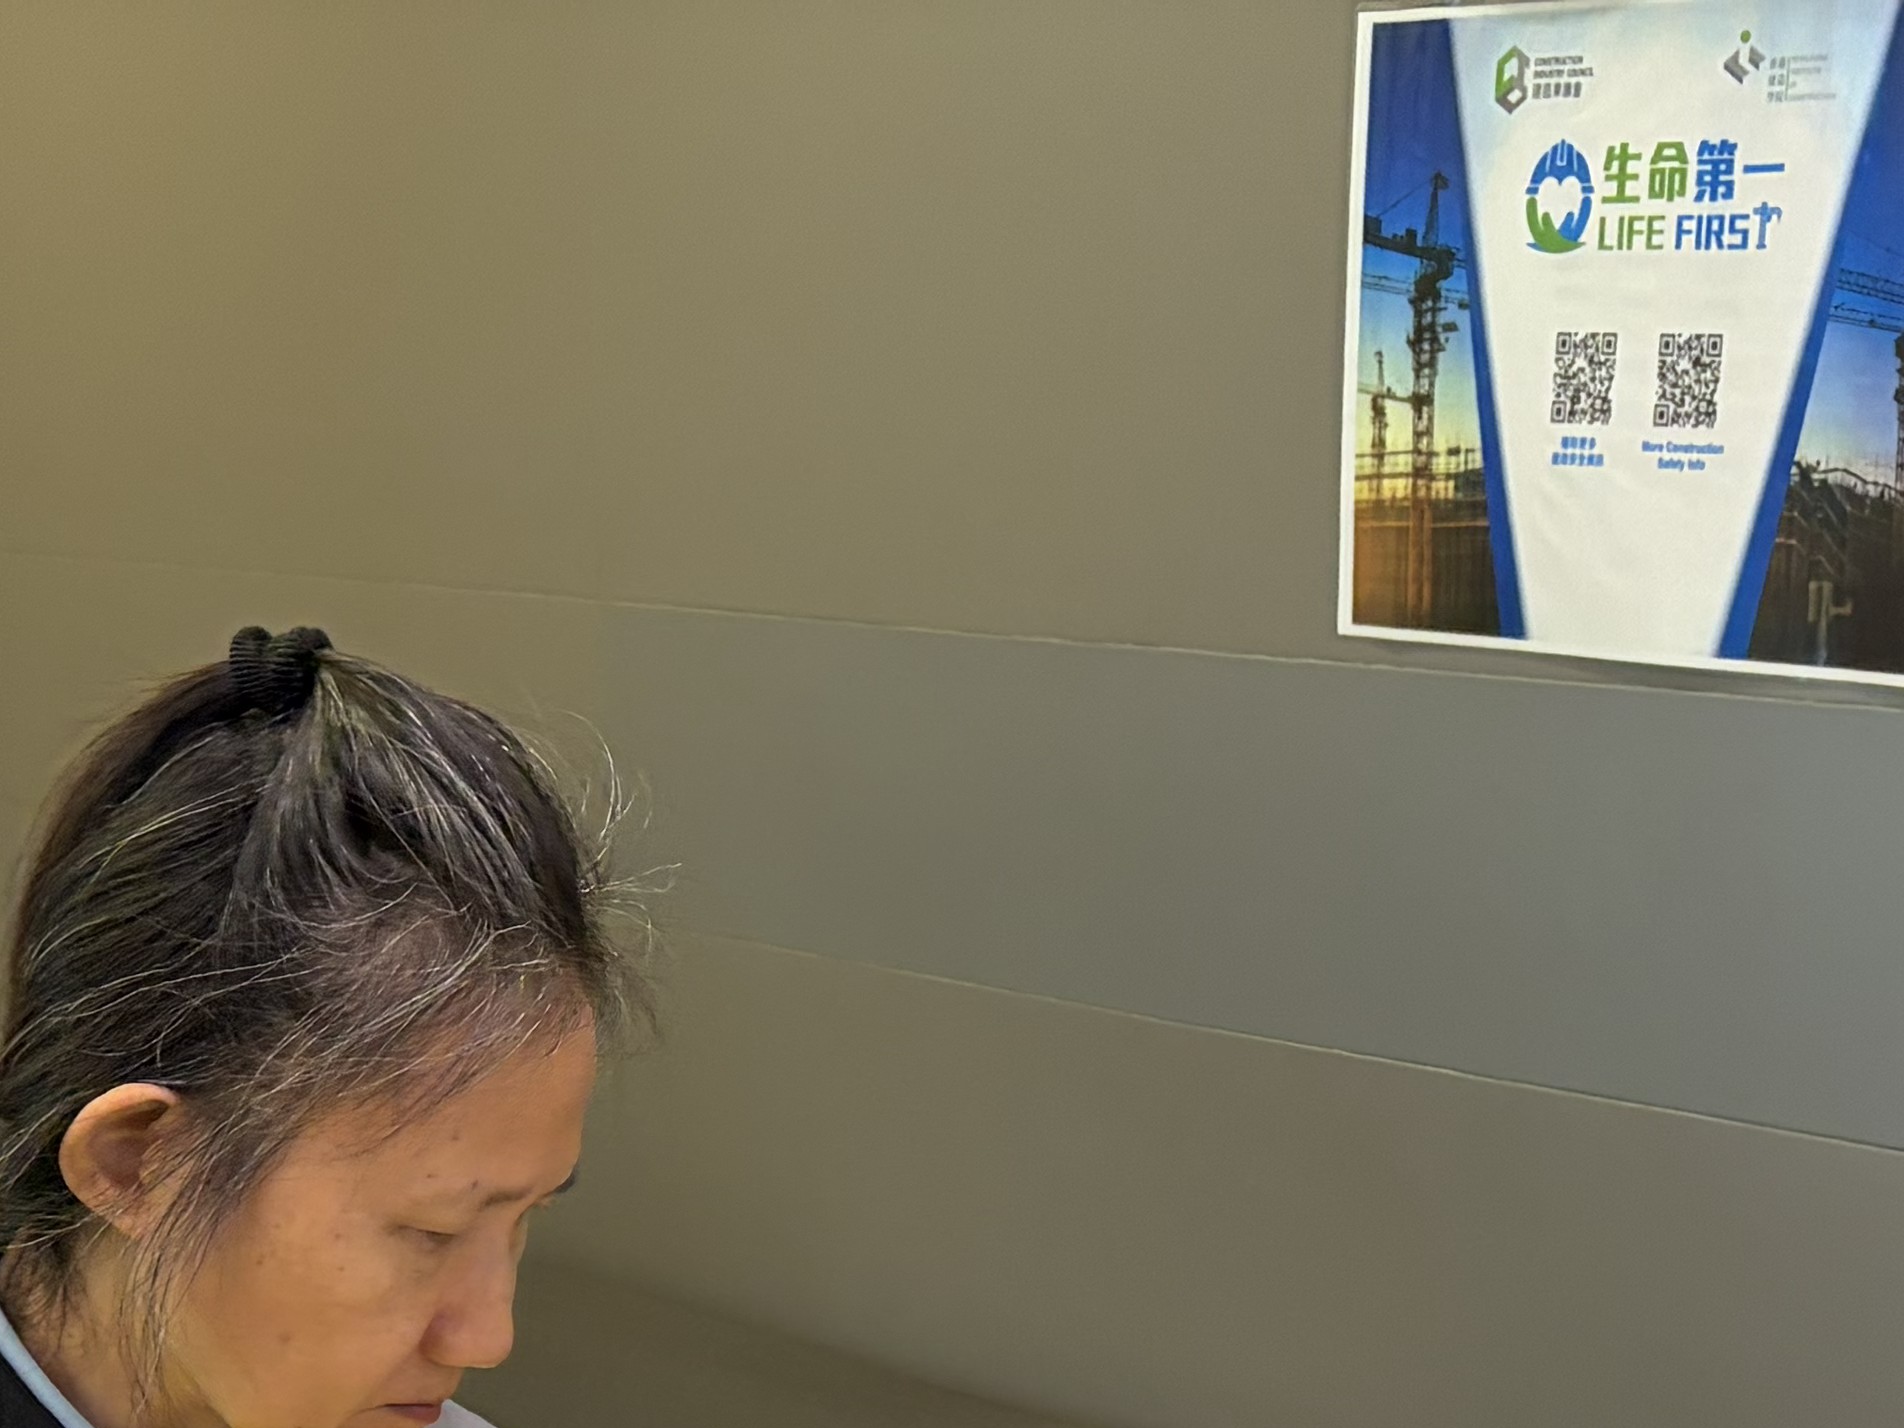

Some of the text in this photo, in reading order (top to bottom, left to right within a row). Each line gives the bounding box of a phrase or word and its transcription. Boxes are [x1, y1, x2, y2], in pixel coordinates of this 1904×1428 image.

[1601, 139, 1785, 203] 生命第一
[1597, 201, 1782, 251] LIFE FIRST
